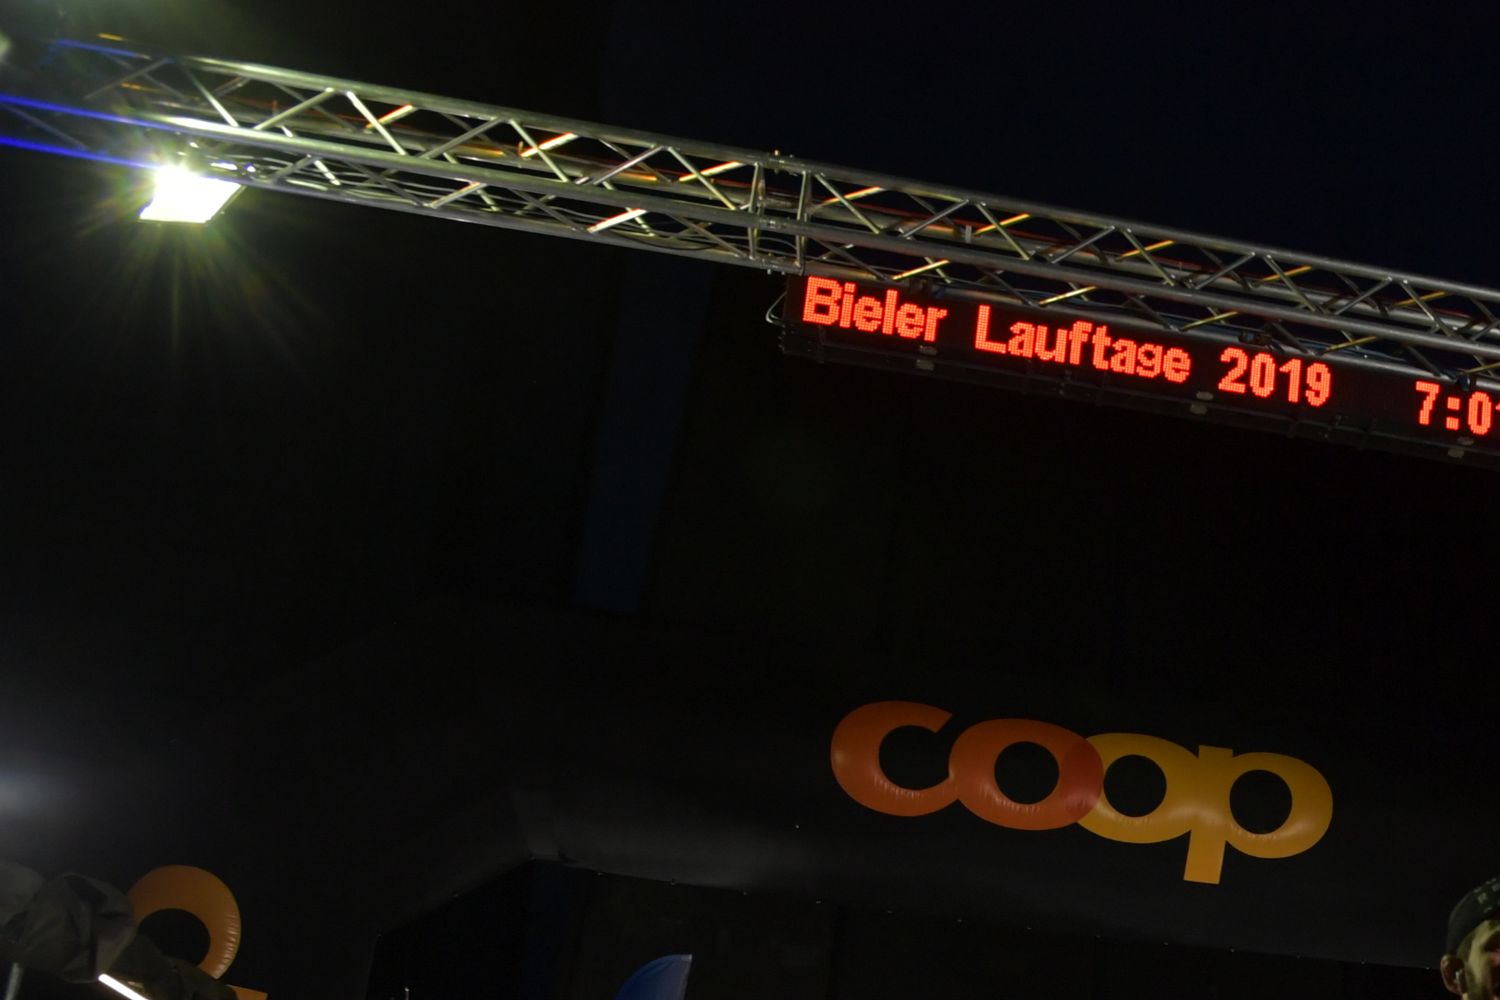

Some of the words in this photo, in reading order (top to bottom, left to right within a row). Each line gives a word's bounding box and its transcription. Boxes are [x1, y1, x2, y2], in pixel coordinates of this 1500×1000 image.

[803, 276, 947, 342] Bieler
[975, 305, 1191, 383] Lauftage
[1218, 347, 1331, 406] 2019
[830, 700, 1333, 884] coop
